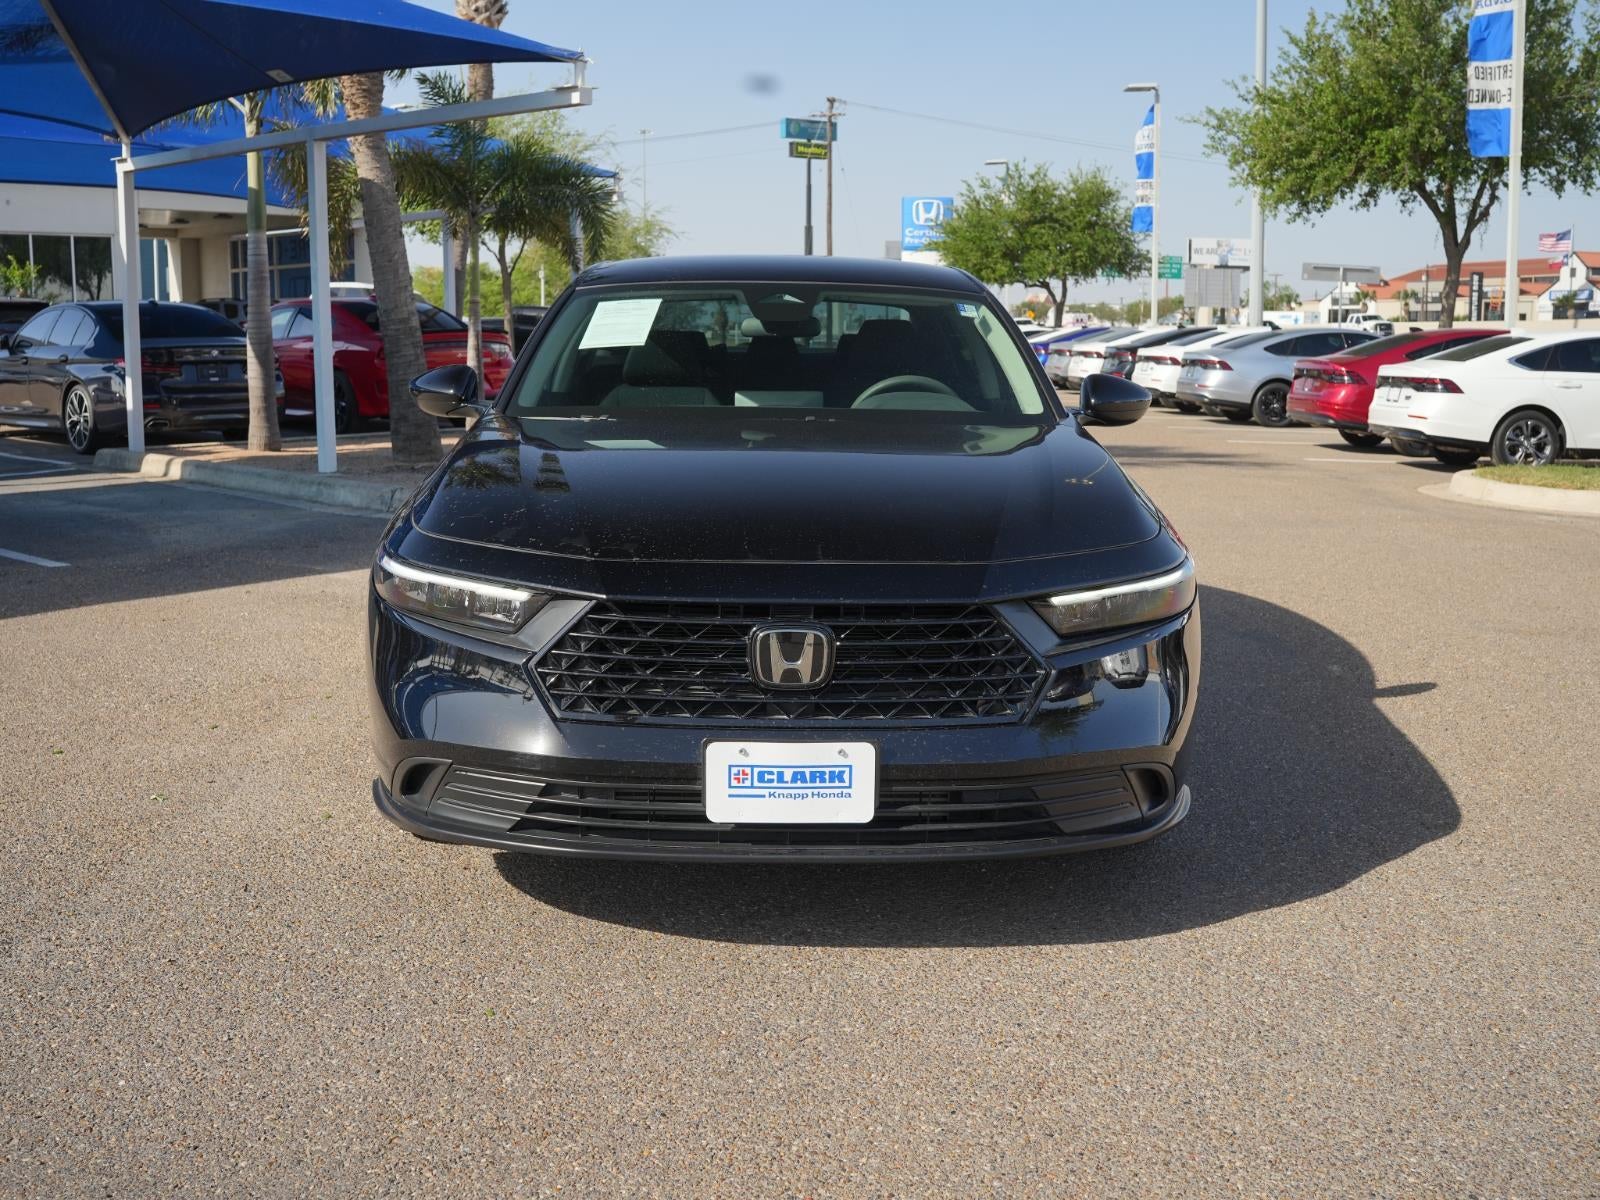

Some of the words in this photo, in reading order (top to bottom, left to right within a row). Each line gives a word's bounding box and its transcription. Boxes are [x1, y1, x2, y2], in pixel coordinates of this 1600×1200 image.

[757, 770, 846, 784] CLARK
[768, 791, 809, 800] Knapp
[811, 791, 852, 799] Honda
